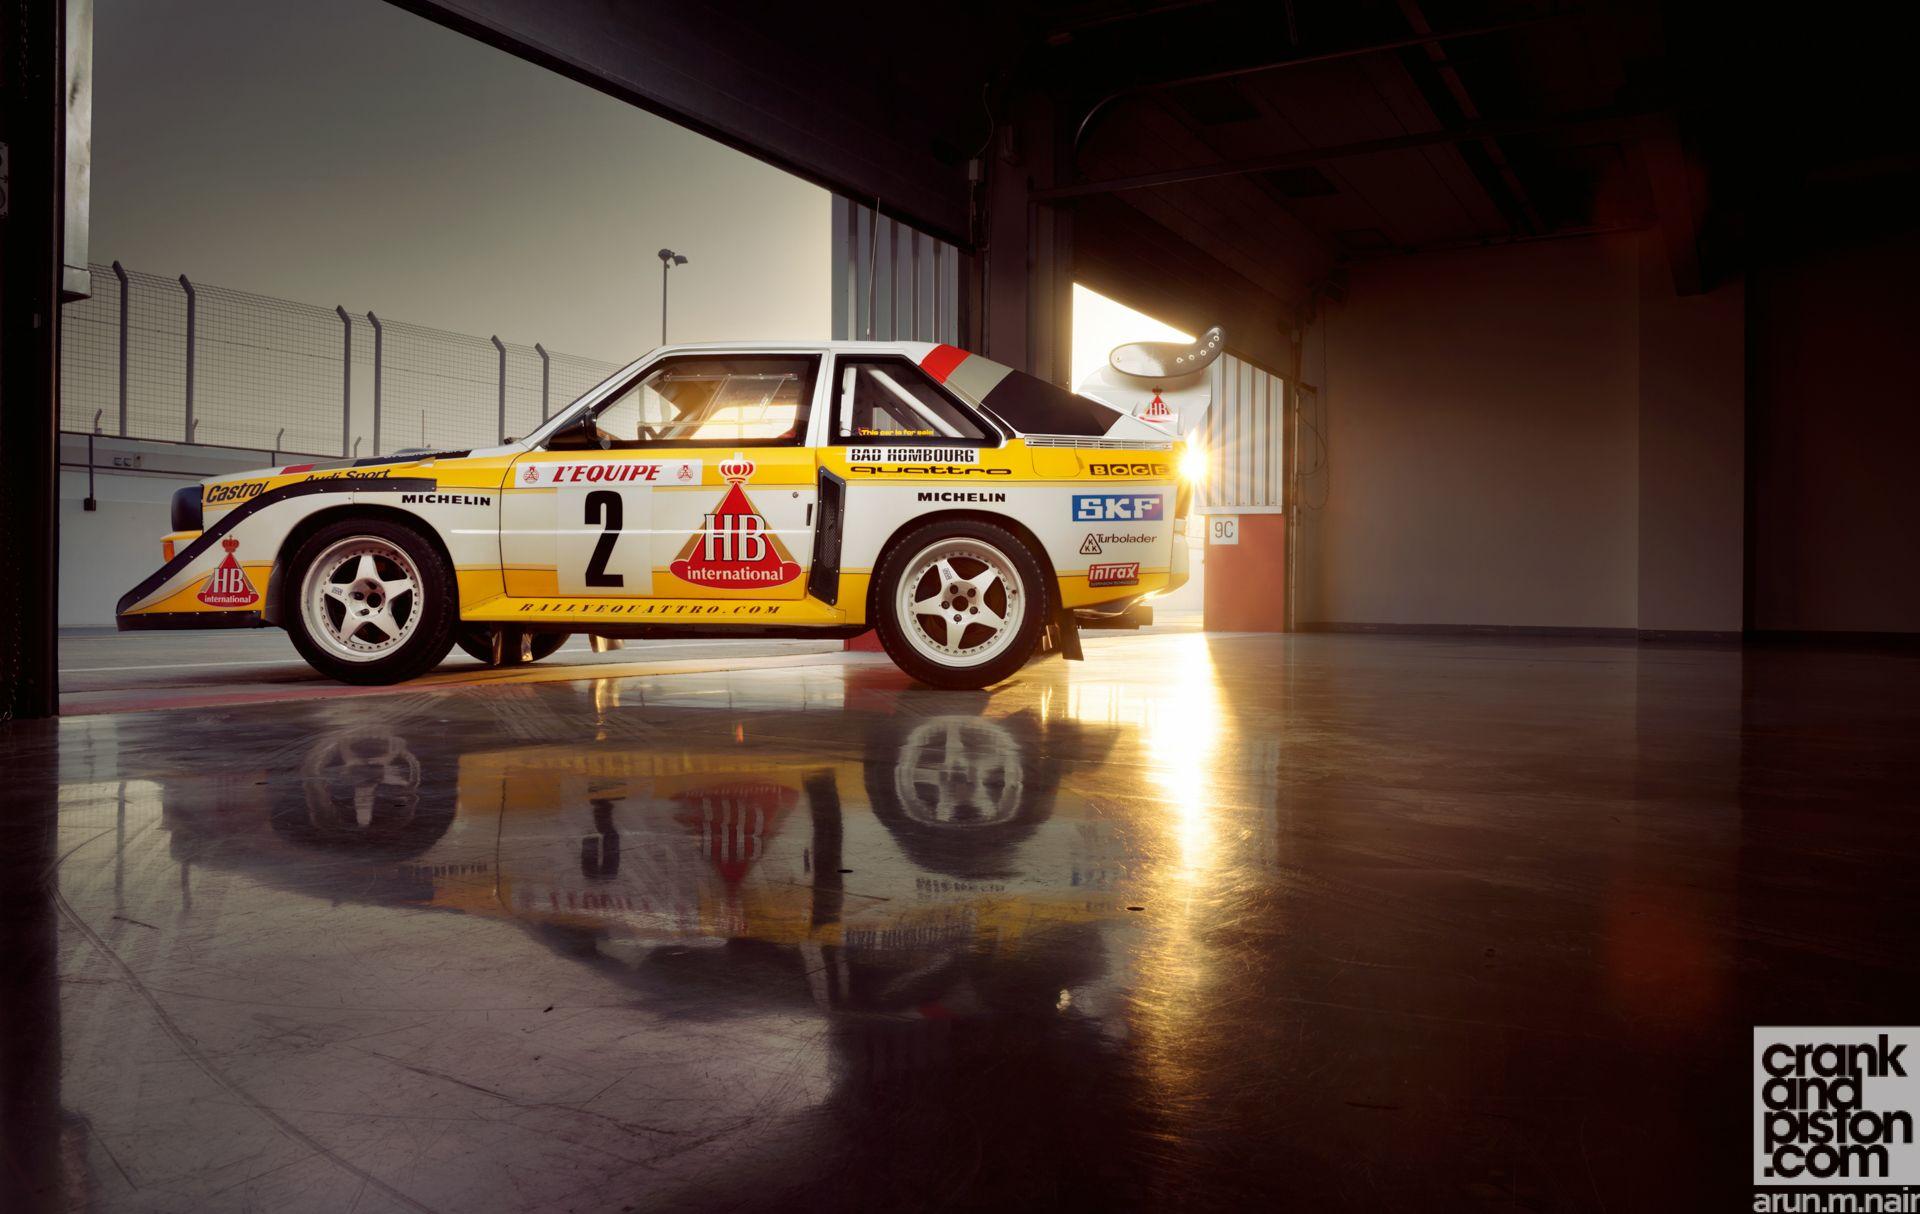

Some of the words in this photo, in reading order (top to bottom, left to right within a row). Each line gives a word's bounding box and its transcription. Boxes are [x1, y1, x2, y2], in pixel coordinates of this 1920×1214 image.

[851, 448, 882, 462] BAD
[887, 448, 974, 462] HOMBOURG
[552, 464, 662, 483] L'EQUIPE
[850, 465, 1012, 475] quattro
[1091, 464, 1169, 476] BOGE
[206, 480, 269, 503] Castrol
[917, 492, 1006, 503] MICHELIN
[401, 494, 491, 507] MICHELIN
[1078, 498, 1160, 519] SKF
[1214, 520, 1234, 538] 9C
[584, 490, 624, 588] 2
[704, 513, 767, 562] HB
[1096, 533, 1158, 544] Turbolader
[213, 567, 245, 593] HB
[687, 565, 784, 581] international
[204, 594, 252, 604] international
[519, 602, 781, 615] RALLYEQUATTRO.COM
